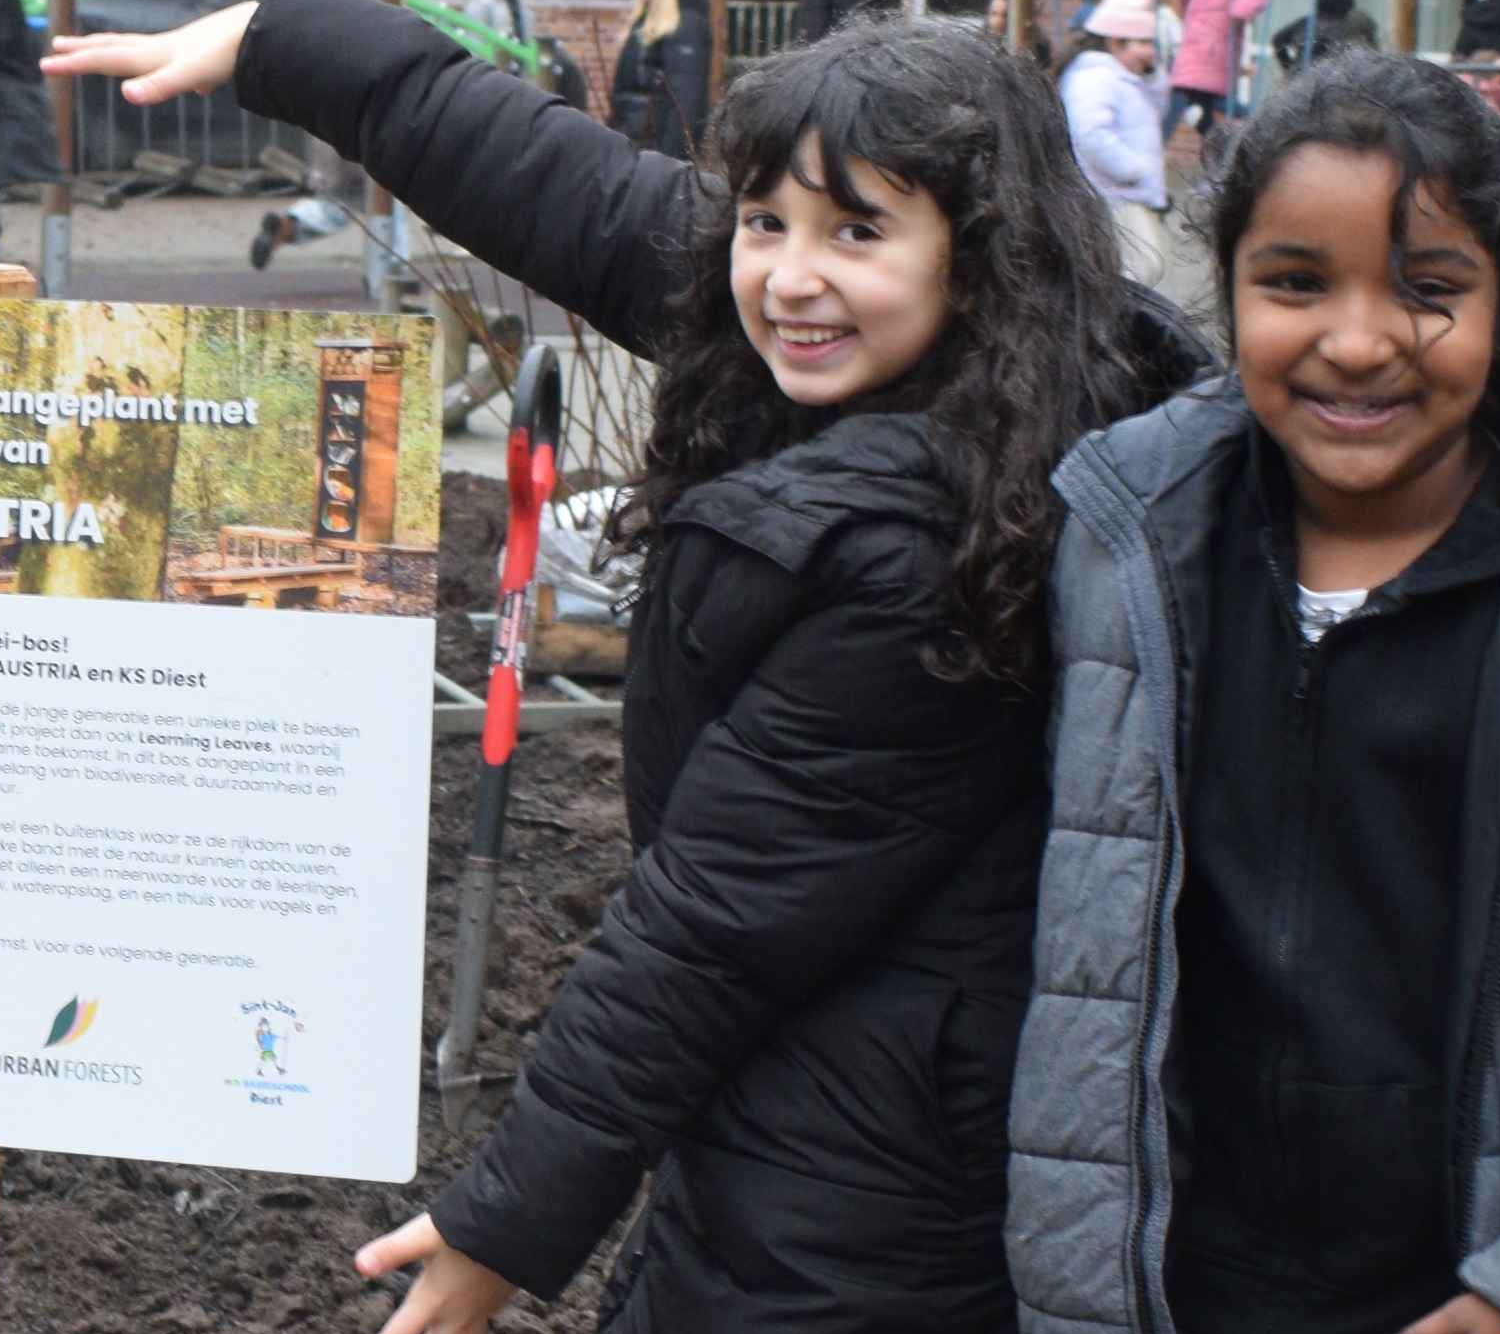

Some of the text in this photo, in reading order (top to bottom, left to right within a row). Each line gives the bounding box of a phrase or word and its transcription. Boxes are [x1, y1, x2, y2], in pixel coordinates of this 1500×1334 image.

[184, 396, 259, 426] met
[86, 667, 114, 683] en
[117, 666, 146, 685] KS
[150, 667, 207, 688] Diest
[8, 722, 66, 741] project
[67, 725, 102, 741] dan
[103, 728, 135, 744] ook
[137, 730, 211, 753] Learning
[279, 741, 341, 762] waarbij
[48, 766, 81, 779] van
[192, 772, 313, 795] duurzaamheid
[314, 784, 337, 797] en
[17, 822, 50, 836] een
[51, 822, 135, 842] buitenklas
[137, 831, 180, 845] waar
[183, 834, 202, 847] ze
[204, 833, 227, 849] de
[229, 835, 291, 854] rijkdom
[294, 842, 327, 856] van
[328, 842, 351, 858] de
[19, 839, 64, 856] band
[66, 845, 100, 859] met
[101, 845, 124, 861] de
[126, 849, 181, 865] natuur
[184, 851, 246, 870] kunnen
[14, 858, 65, 876] alleen
[68, 865, 100, 878] een
[101, 867, 208, 887] meerwaarde
[209, 875, 248, 890] voor
[249, 875, 272, 892] de
[117, 888, 139, 901] en
[140, 889, 173, 903] een
[174, 890, 217, 907] thuis
[218, 895, 255, 910] voor
[257, 898, 313, 917] vogels
[315, 903, 338, 916] en
[32, 937, 71, 954] Voor
[72, 940, 96, 956] de
[97, 943, 173, 963] volgende
[63, 1060, 144, 1086] FORESTS
